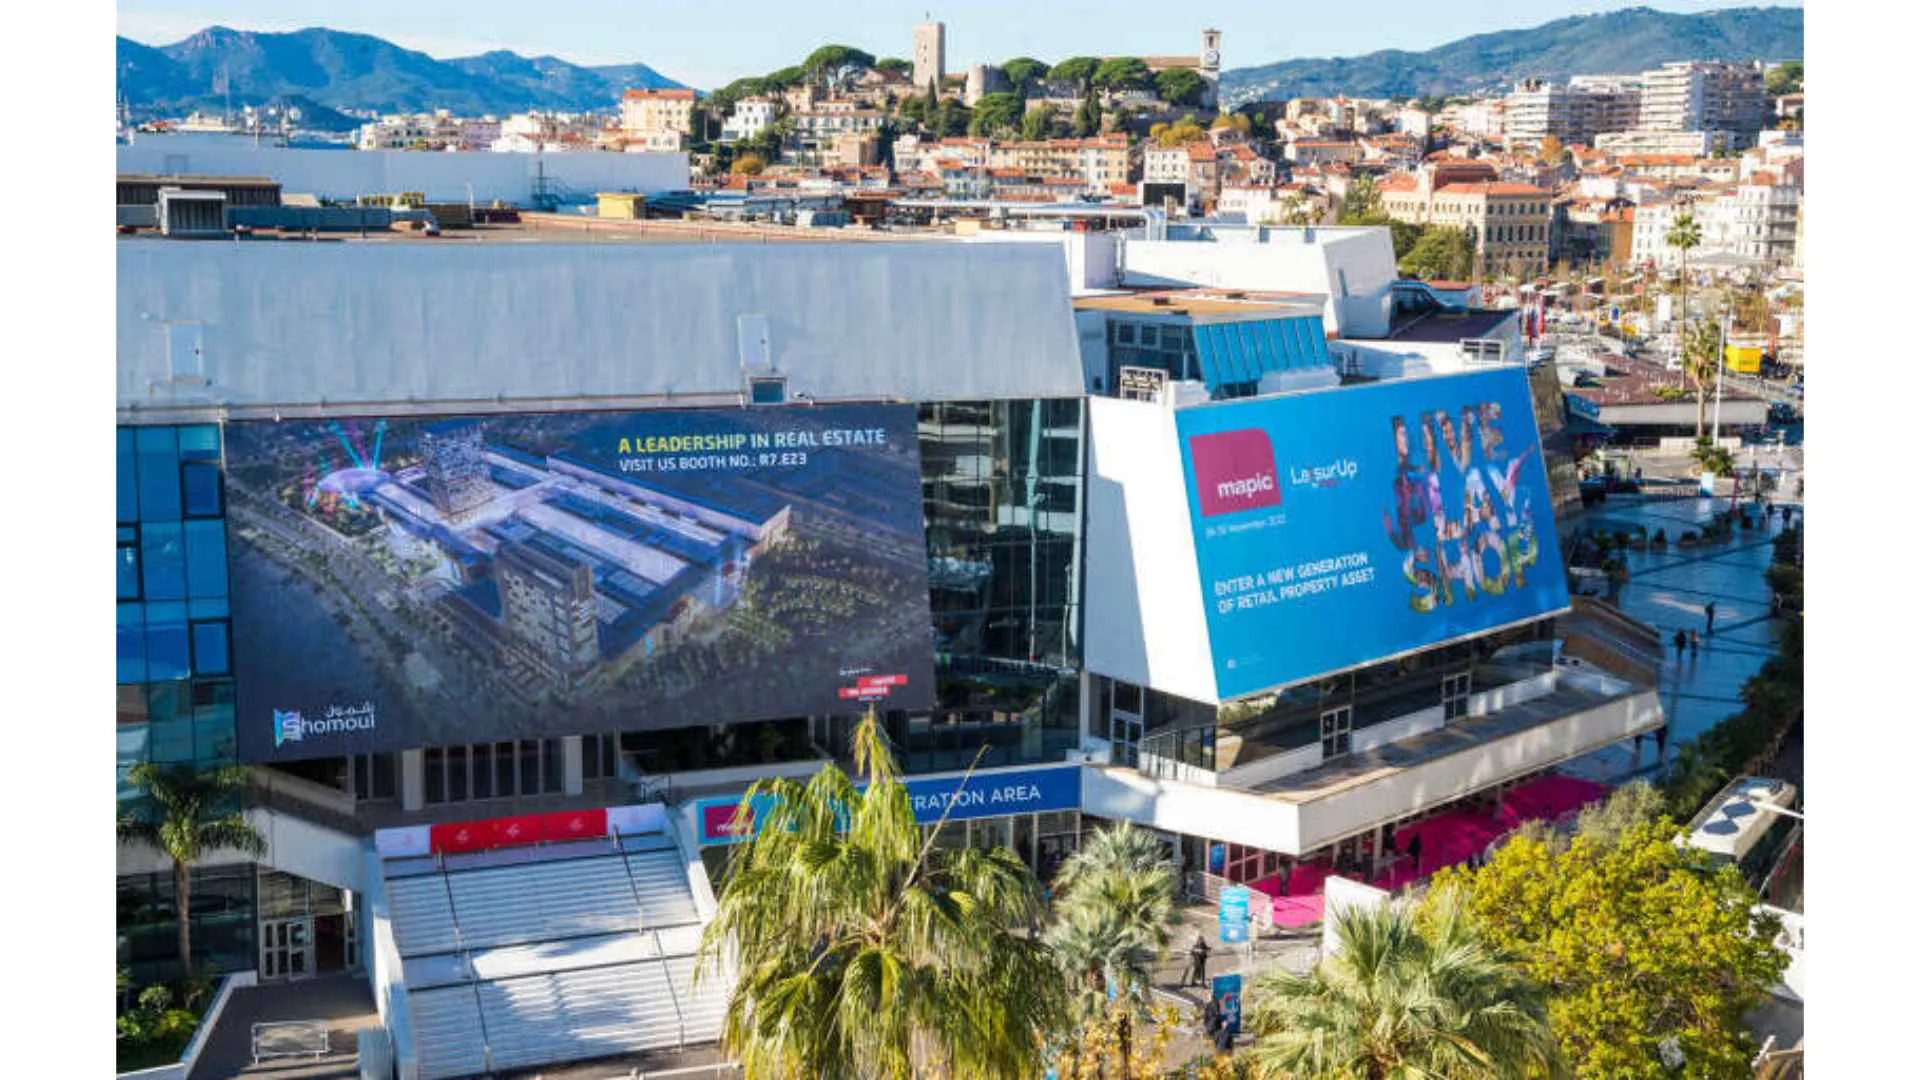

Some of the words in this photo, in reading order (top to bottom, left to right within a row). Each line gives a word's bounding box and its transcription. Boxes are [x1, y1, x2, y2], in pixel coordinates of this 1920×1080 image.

[618, 439, 632, 454] A
[636, 434, 746, 453] LEADERSHIP
[750, 433, 769, 448] IN
[774, 431, 818, 449] REAL
[822, 428, 886, 447] ESTATE
[1392, 401, 1507, 473] LIVE
[619, 458, 652, 472] VISIT
[657, 456, 676, 471] US
[679, 455, 724, 470] BOOTH
[1217, 473, 1273, 499] mapic
[1384, 444, 1536, 550] PLAY
[1215, 575, 1254, 596] ENTER
[1256, 573, 1265, 587] A
[1267, 566, 1294, 584] NEW
[1297, 551, 1369, 579] GENERATION
[1403, 530, 1538, 613] SHOP
[1217, 598, 1235, 615] OF
[1238, 590, 1278, 609] RETAIL
[1279, 576, 1339, 600] PROPERTY
[1341, 566, 1376, 587] ASSET
[282, 711, 375, 740] Shomoul
[991, 784, 1041, 803] AREA
